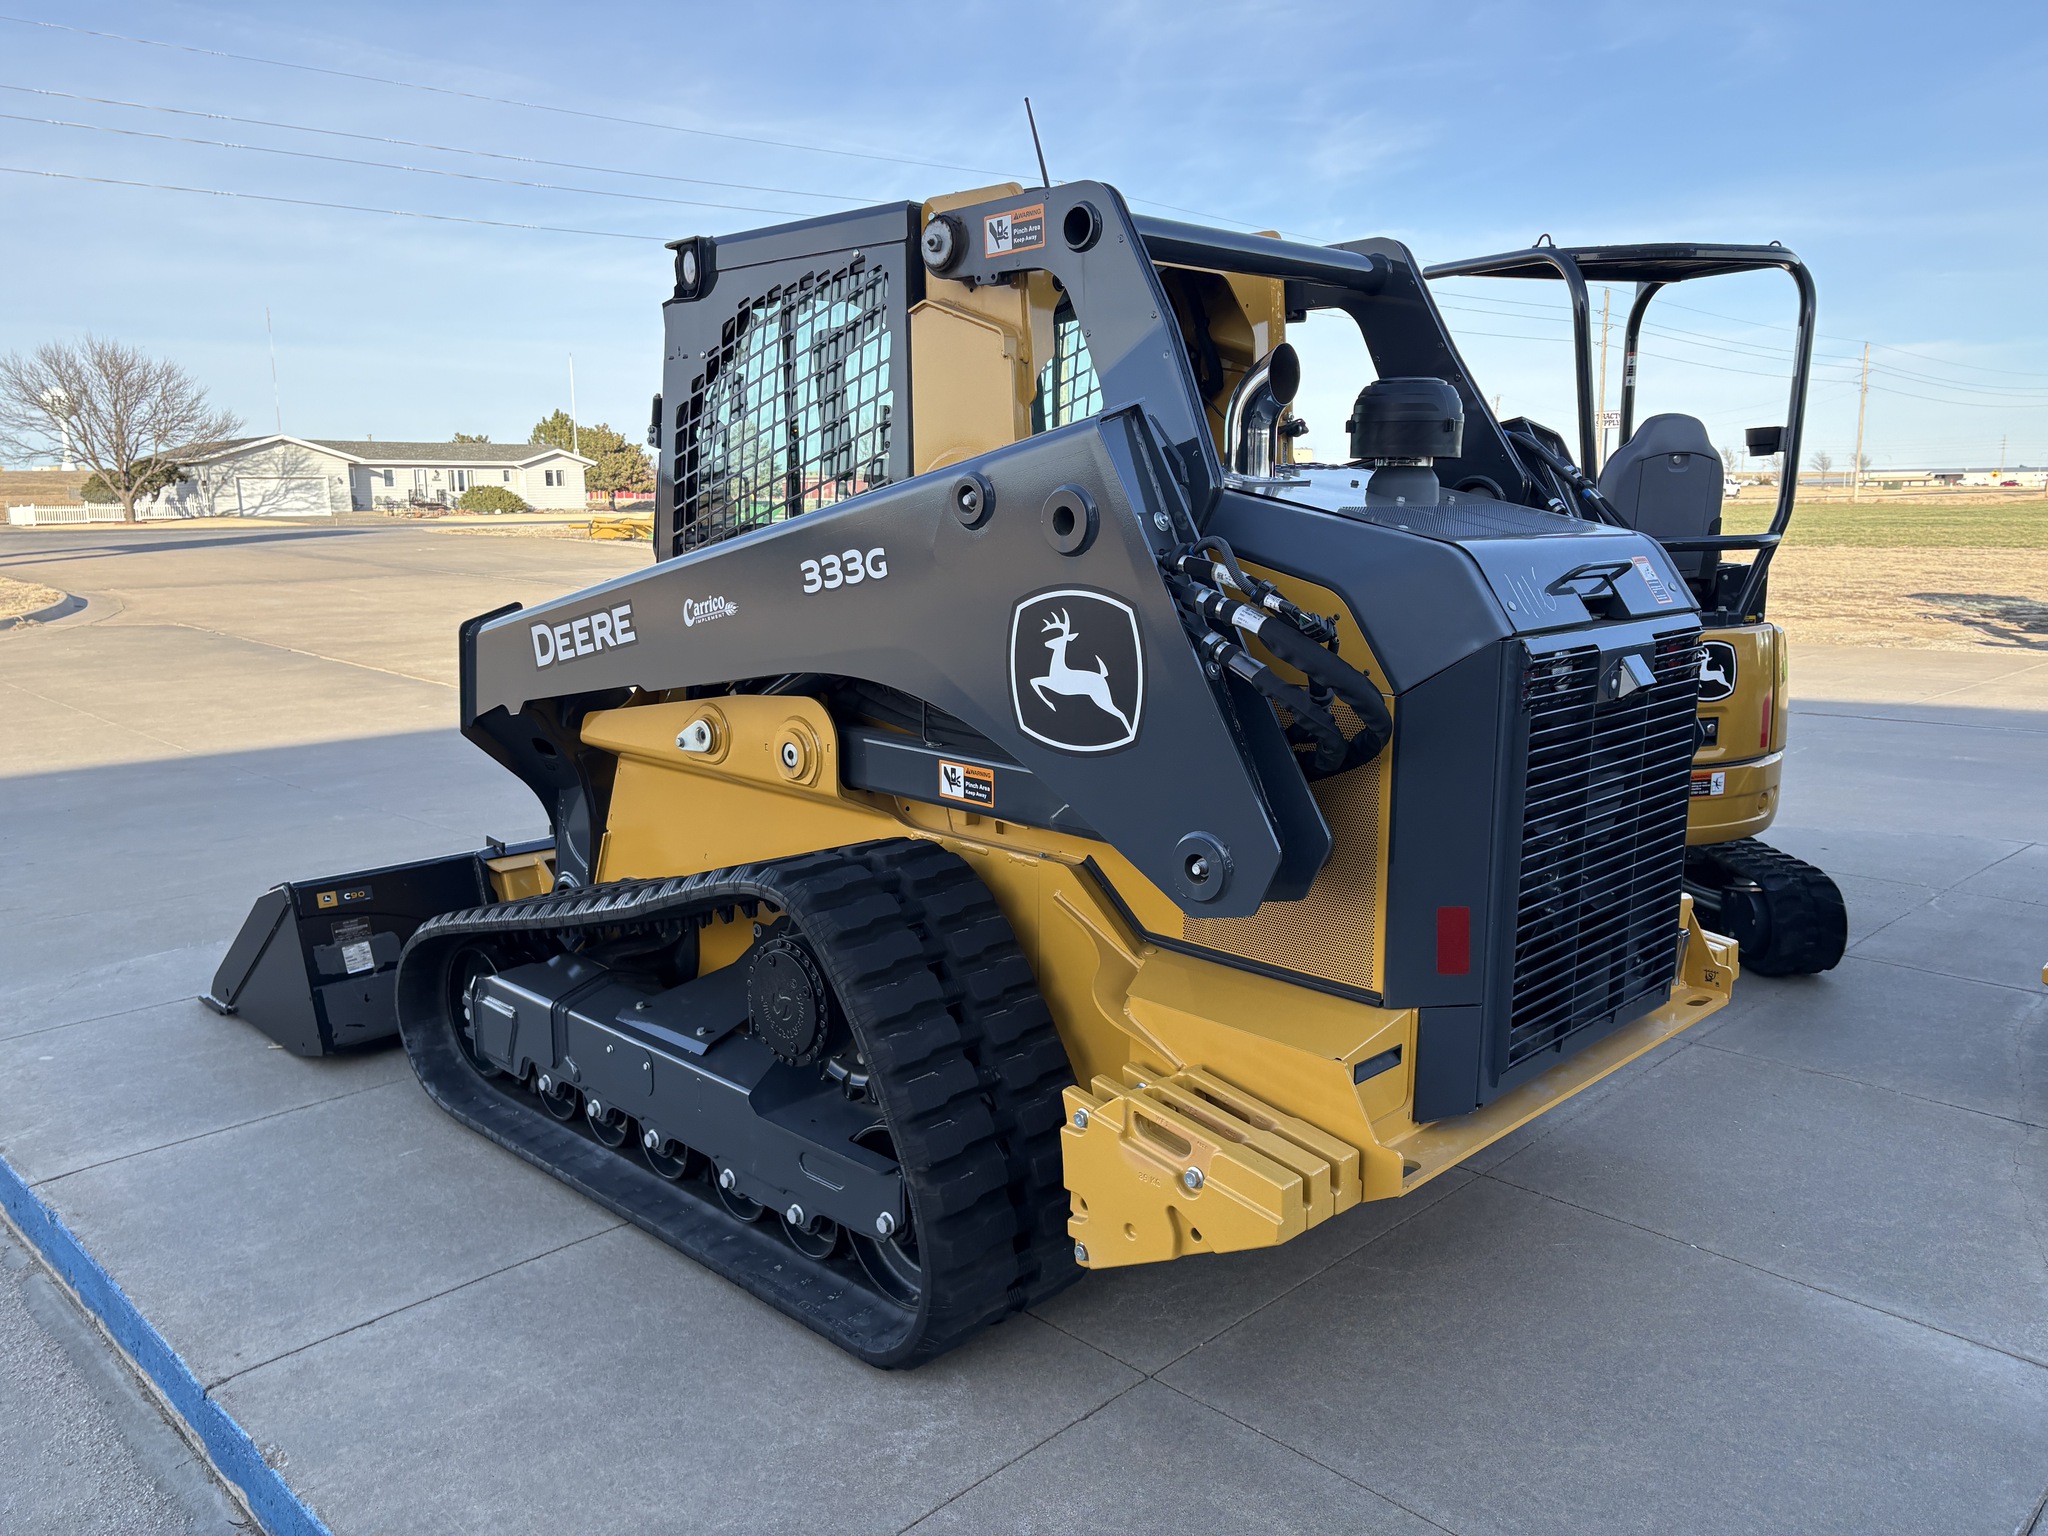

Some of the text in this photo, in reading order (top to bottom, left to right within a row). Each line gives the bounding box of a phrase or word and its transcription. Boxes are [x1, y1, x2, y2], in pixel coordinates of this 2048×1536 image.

[1019, 208, 1041, 218] WARNING
[1013, 227, 1028, 235] Pinch
[1013, 236, 1025, 244] Keep
[800, 547, 888, 594] 333G
[683, 594, 725, 627] Carrico
[695, 613, 725, 624] IMPLEMENT
[530, 604, 636, 668] DEERE
[970, 770, 991, 778] WARNING
[965, 781, 979, 789] Pinch
[976, 791, 987, 799] Away
[344, 891, 365, 900] C90
